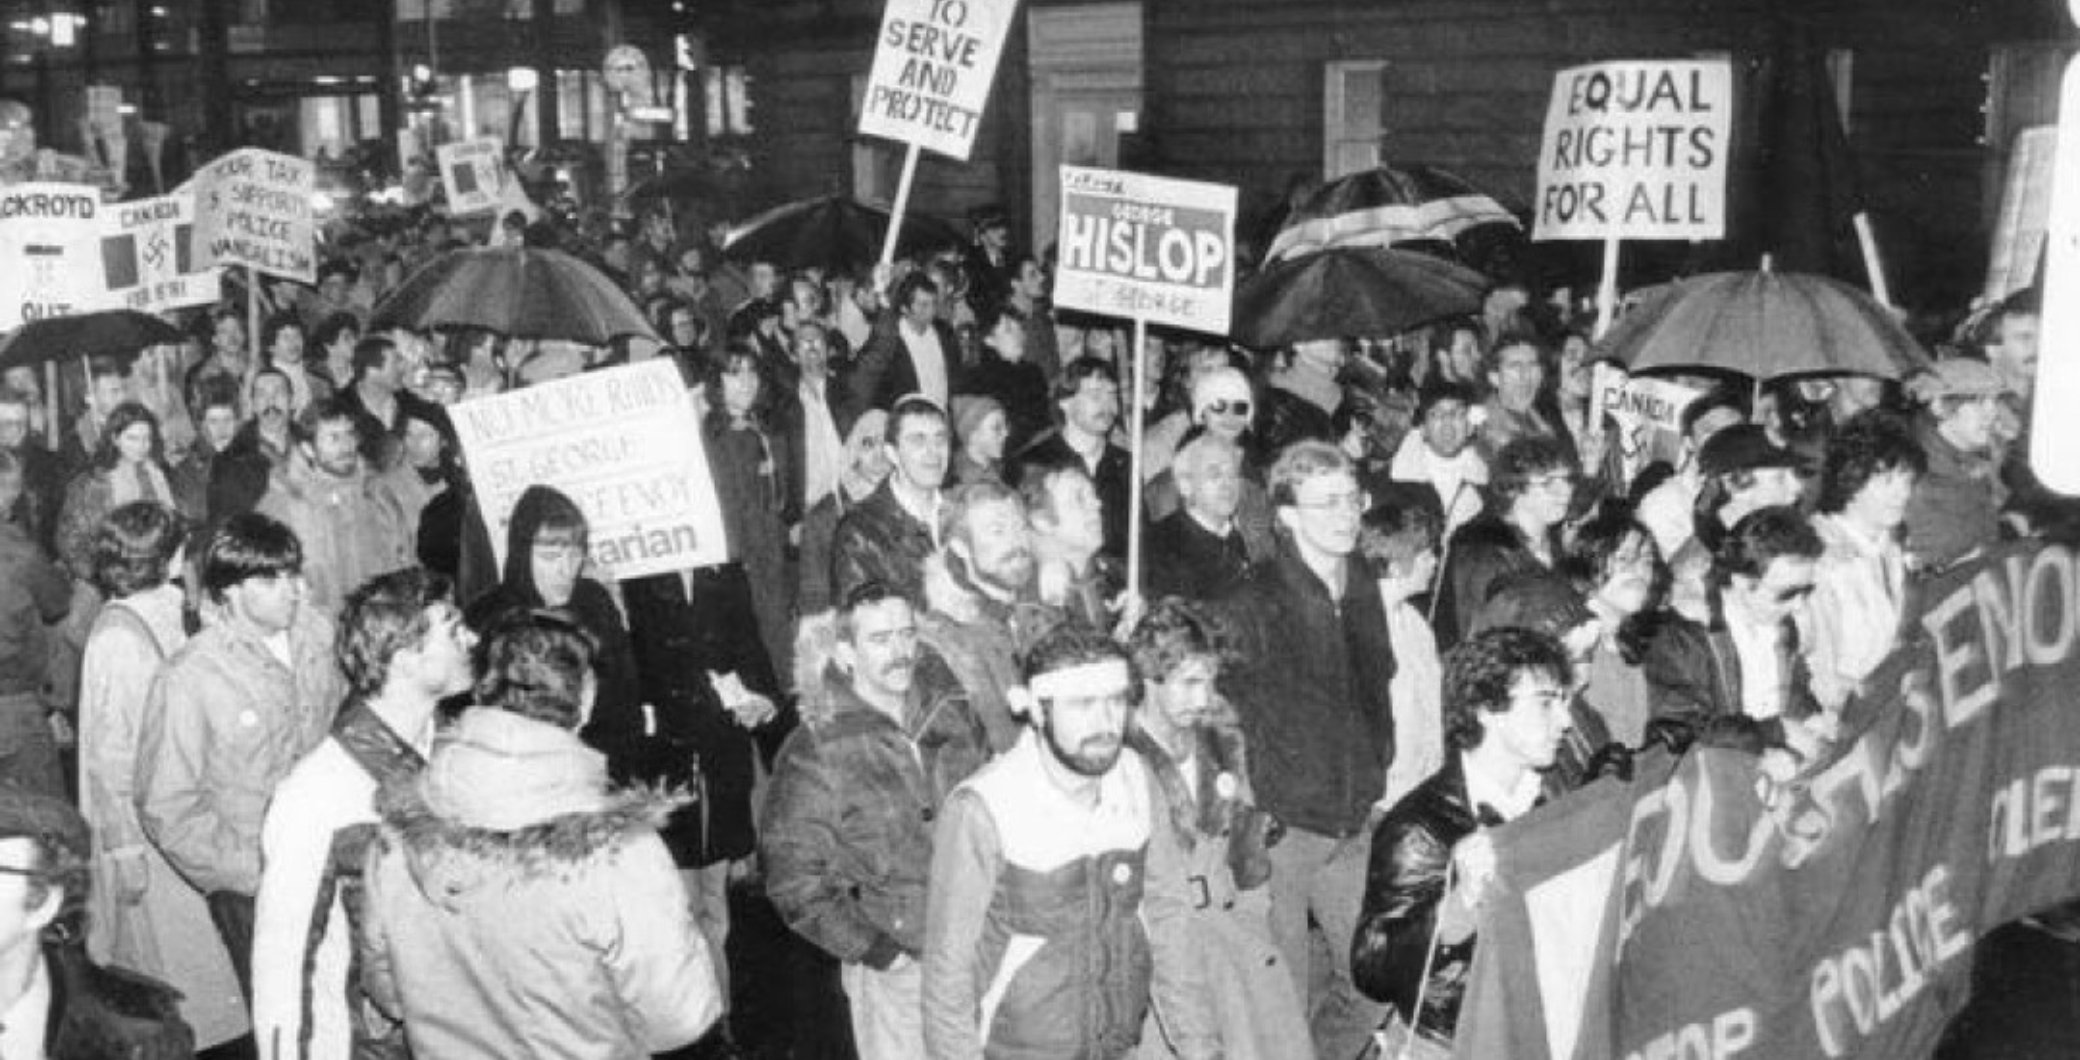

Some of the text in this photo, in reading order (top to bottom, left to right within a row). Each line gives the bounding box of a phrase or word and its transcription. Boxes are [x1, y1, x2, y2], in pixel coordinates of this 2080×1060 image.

[886, 18, 981, 68] SERVE
[899, 57, 958, 97] AND
[1568, 69, 1712, 117] EQUAL
[869, 85, 981, 139] PROTECT
[1553, 124, 1716, 170] RIGHTS
[0, 193, 95, 219] CKROYD
[120, 202, 180, 228] CANADA
[1543, 181, 1706, 226] FOR ALL
[226, 212, 292, 242] POLICE
[1064, 211, 1226, 287] HISLOP
[1603, 387, 1675, 424] CANADA
